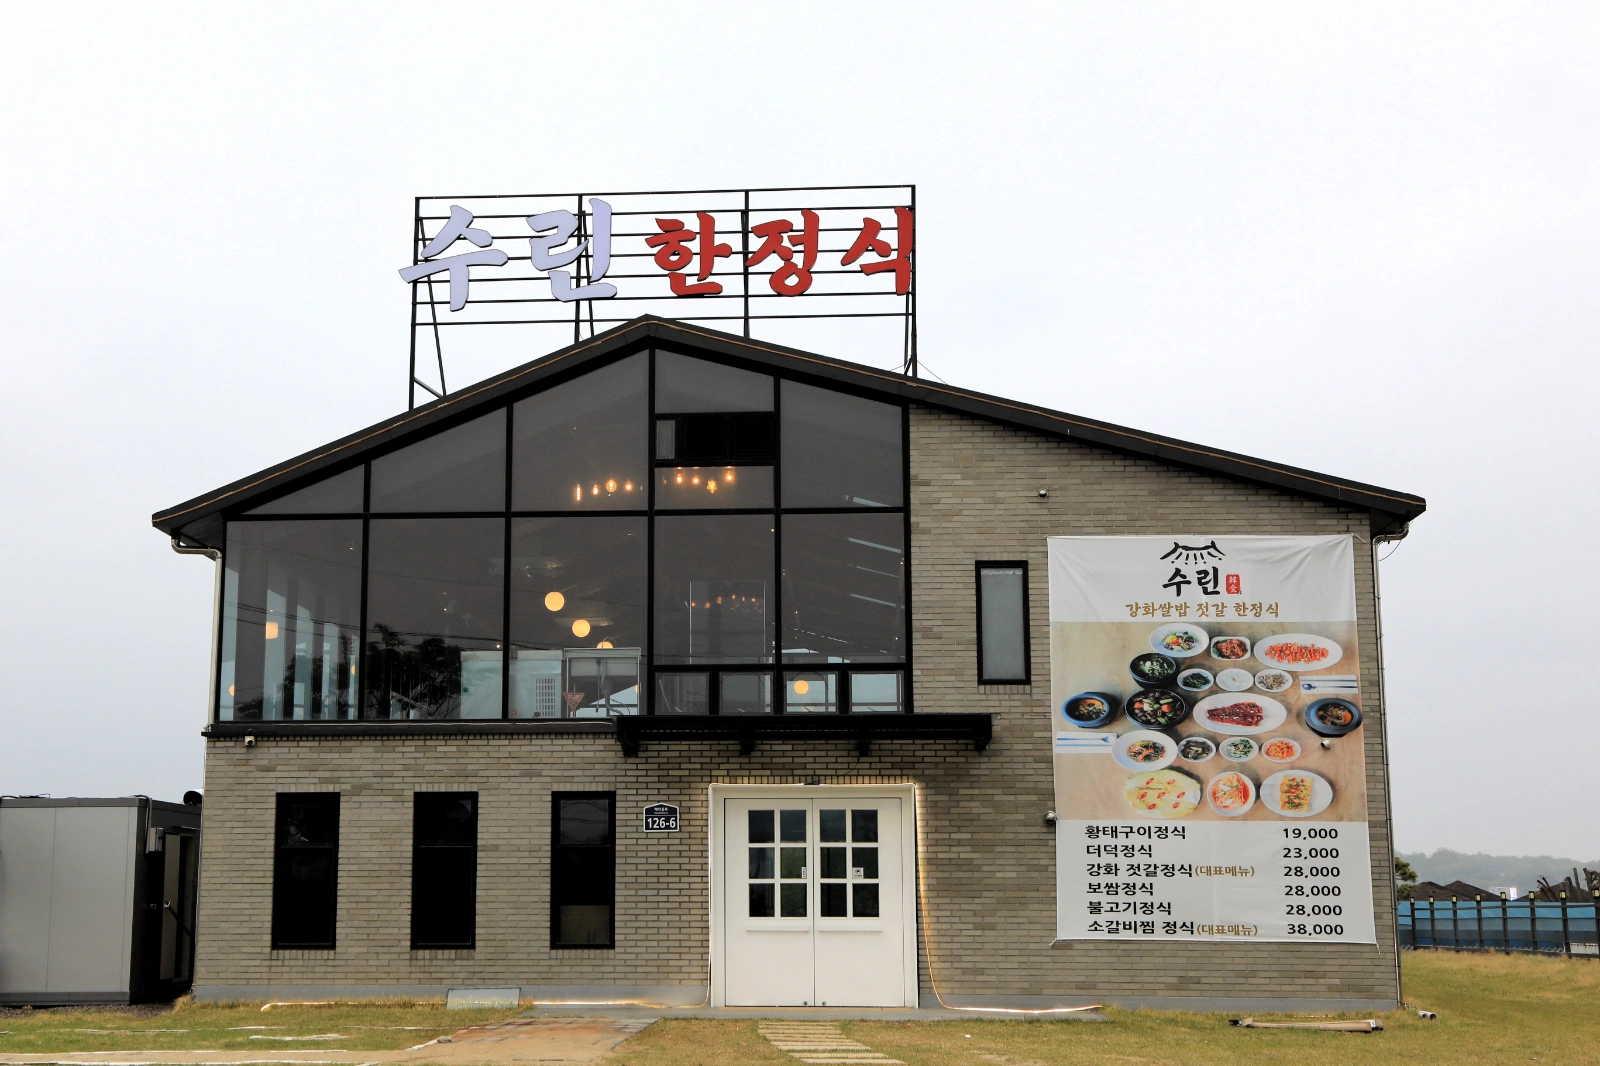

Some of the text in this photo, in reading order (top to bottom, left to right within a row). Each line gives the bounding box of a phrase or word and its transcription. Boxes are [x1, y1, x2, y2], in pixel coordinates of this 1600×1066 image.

[398, 198, 914, 311] 수린 한정식
[1162, 566, 1221, 597] 수린
[1125, 602, 1280, 619] 강화쌀밥 젓갈 한정식
[647, 817, 676, 829] 126-6
[1084, 825, 1186, 840] 황태구이정식
[1282, 827, 1339, 841] 19,000
[1086, 844, 1153, 858] 더덕정식
[1282, 847, 1340, 860] 23,000
[1086, 863, 1120, 877] 강화
[1283, 866, 1341, 879] 28,000
[1086, 882, 1154, 896] 보쌈정식
[1284, 885, 1342, 898] 28,000
[1087, 901, 1172, 915] 불고기정식
[1285, 904, 1343, 917] 28,000
[1087, 920, 1155, 935] 소갈비찜
[1287, 923, 1344, 937] 38,000
